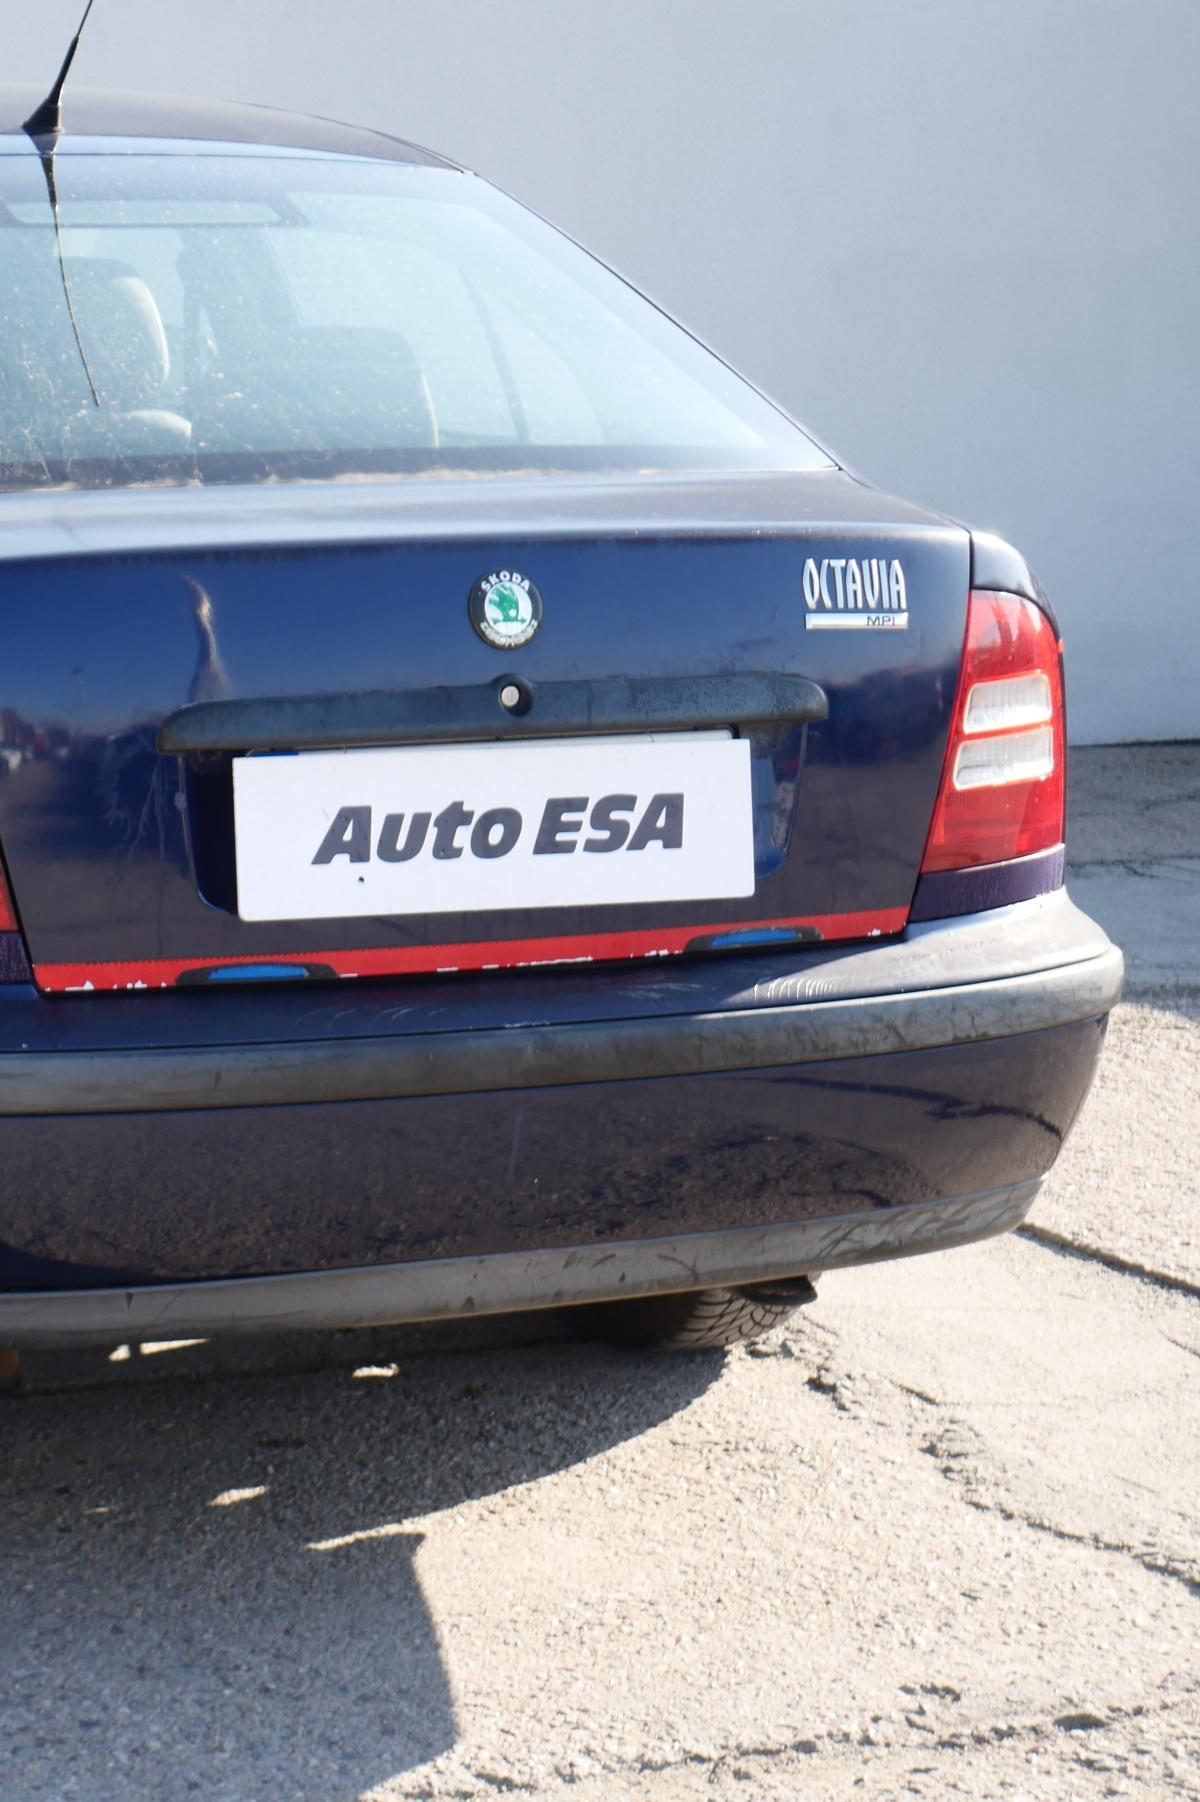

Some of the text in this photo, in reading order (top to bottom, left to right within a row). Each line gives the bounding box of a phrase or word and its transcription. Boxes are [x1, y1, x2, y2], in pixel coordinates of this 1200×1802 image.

[803, 558, 907, 609] OCTAVIA
[866, 615, 896, 627] MPI
[310, 792, 685, 865] Auto ESA
